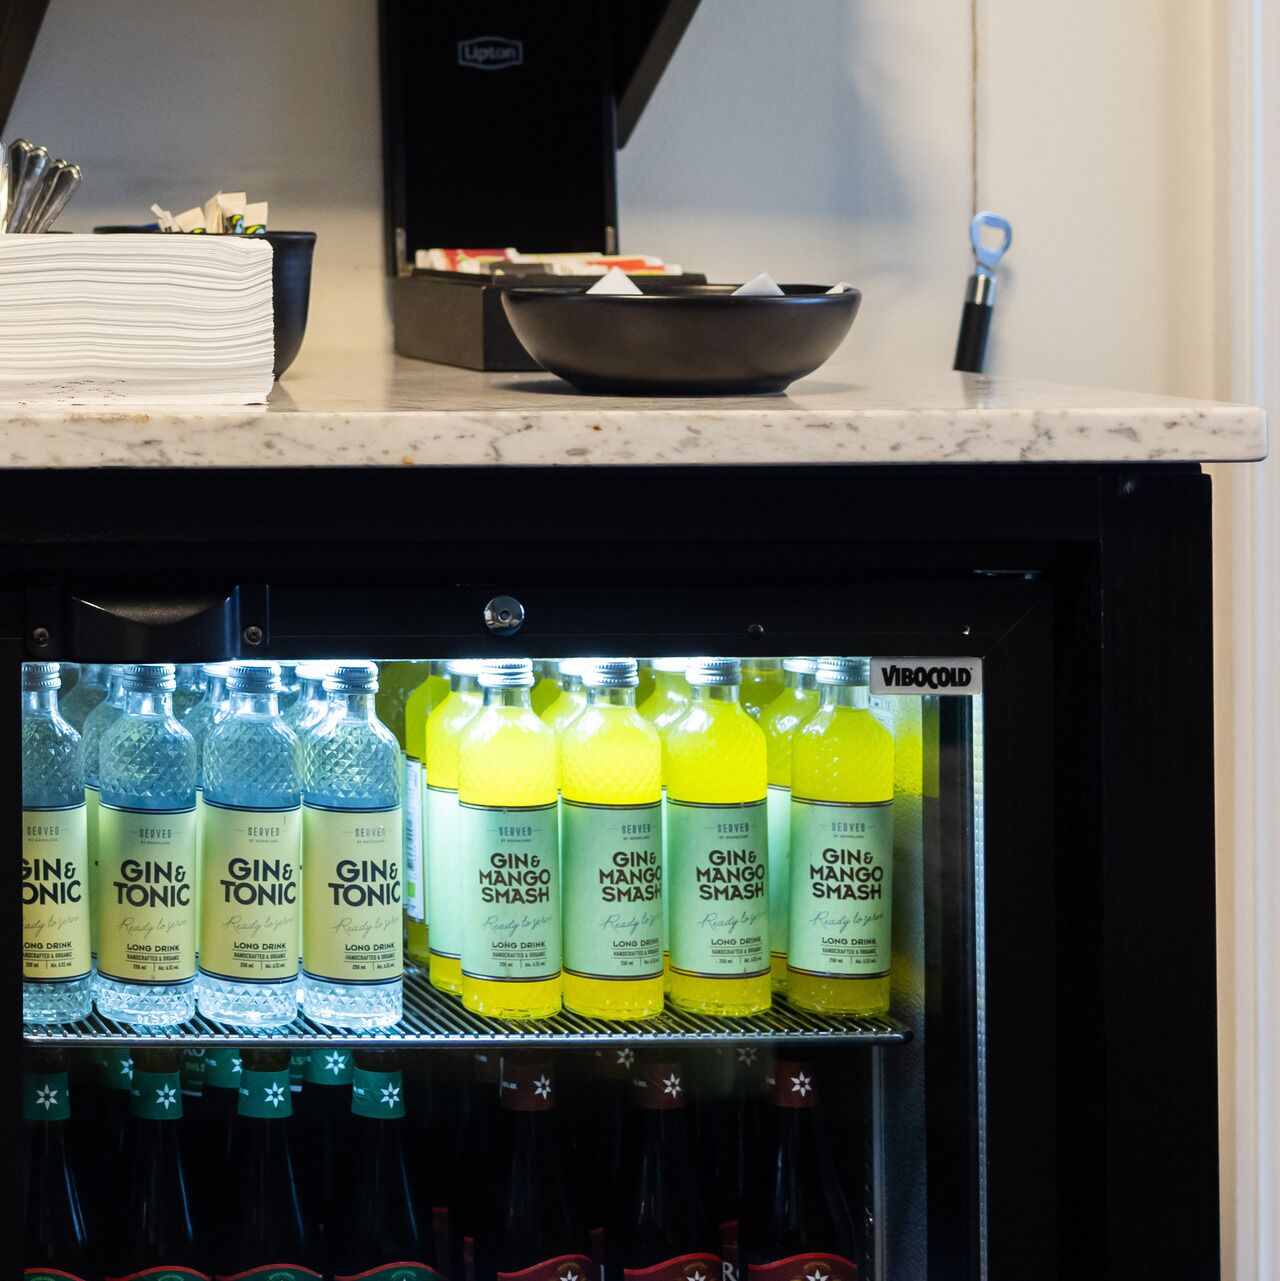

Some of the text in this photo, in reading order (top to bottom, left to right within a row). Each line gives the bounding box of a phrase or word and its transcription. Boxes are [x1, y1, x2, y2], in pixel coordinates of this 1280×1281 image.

[464, 45, 517, 63] Lipton
[881, 665, 972, 689] VIBOCOLD
[27, 826, 60, 836] SERVED
[140, 829, 172, 838] SERVED
[248, 827, 280, 836] SERVED
[499, 827, 533, 836] SERVED
[491, 853, 541, 869] GIN&
[612, 851, 656, 867] GIN&
[708, 849, 756, 866] GIN&
[822, 848, 873, 865] GIN&
[120, 859, 186, 883] GIN&
[228, 858, 293, 881] GIN&
[336, 859, 398, 882] GIN&
[479, 869, 551, 887] MANGO
[599, 866, 662, 885] MANGO
[696, 864, 765, 883] MANGO
[810, 864, 884, 882] MANGO
[22, 880, 82, 905] ONIC
[113, 881, 190, 908] TONIC
[220, 880, 296, 906] TONIC
[328, 880, 401, 907] TONIC
[481, 886, 550, 904] SMASH
[602, 884, 662, 902] SMASH
[699, 882, 764, 900] SMASH
[812, 882, 882, 900] SMASH
[118, 917, 153, 939] Ready
[598, 913, 640, 936] Ready
[697, 912, 738, 934] Ready
[809, 910, 850, 933] Ready
[127, 944, 152, 952] LONG
[234, 941, 259, 950] LONG
[373, 942, 395, 951] DRINK
[492, 941, 517, 949] LONG
[740, 936, 761, 945] DRINK
[822, 937, 877, 946] LONG DRINK
